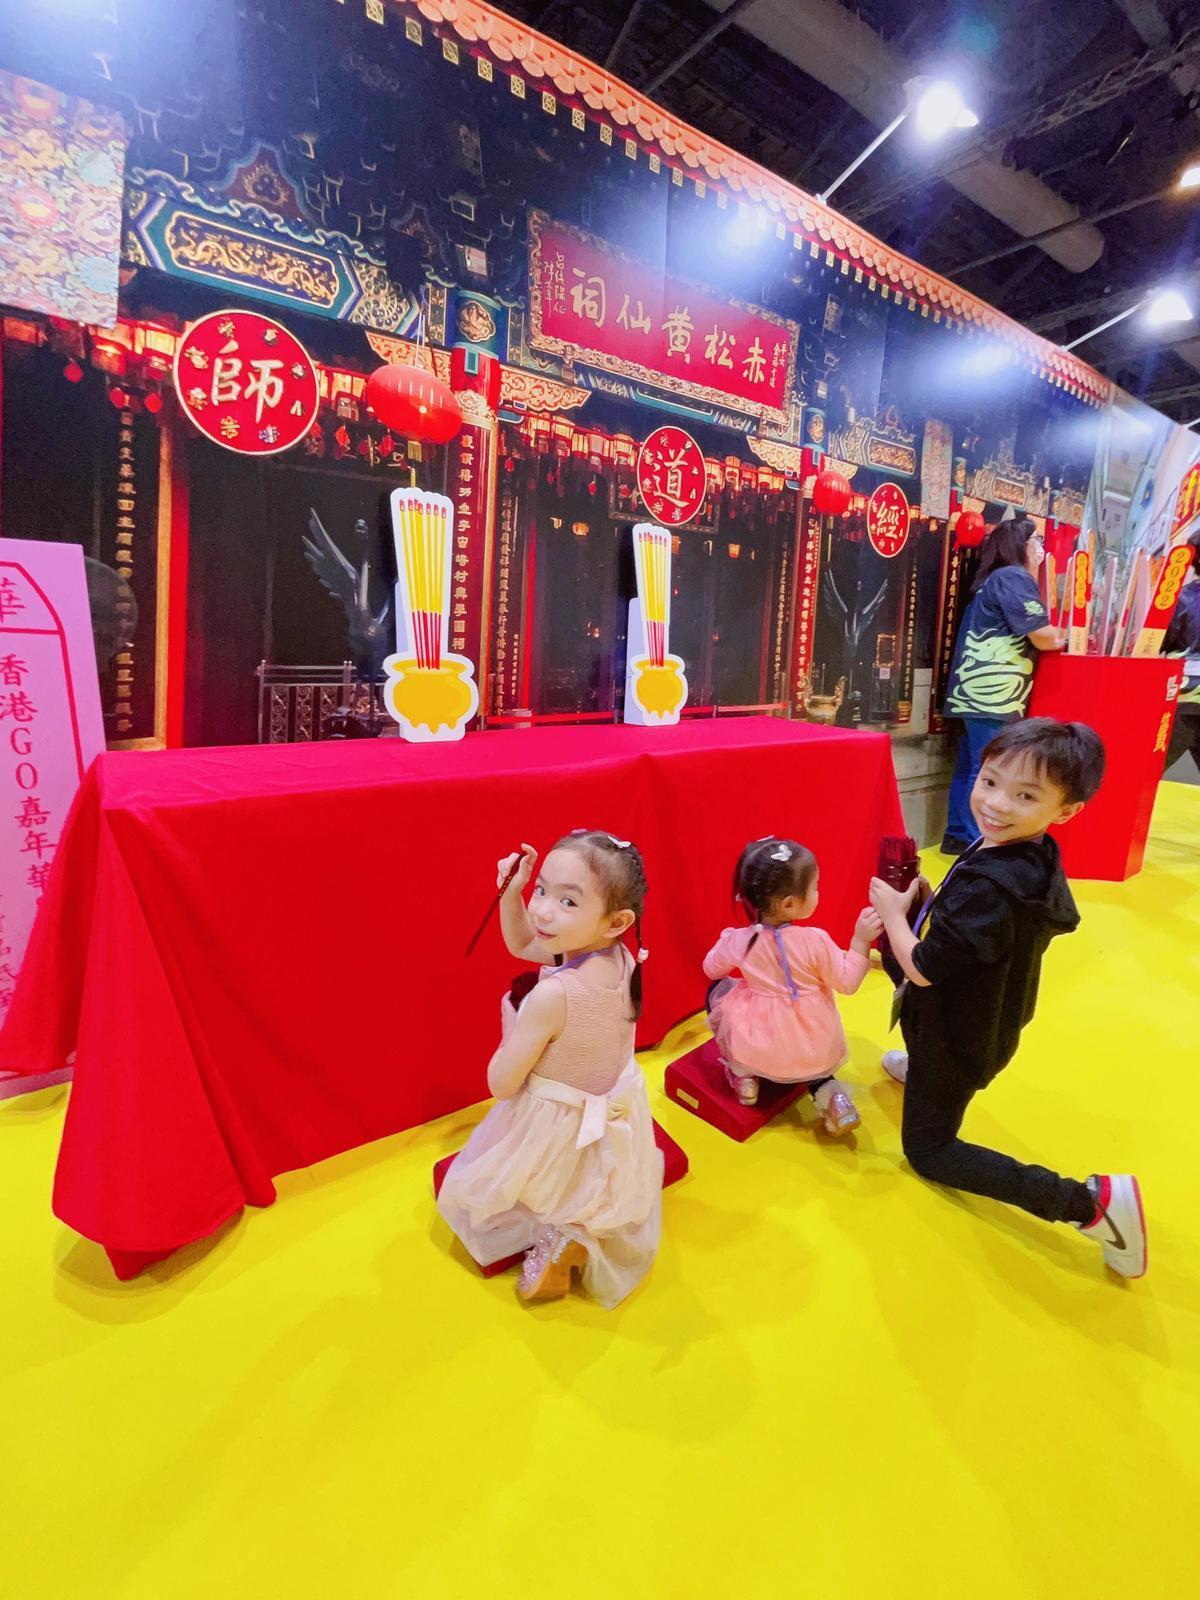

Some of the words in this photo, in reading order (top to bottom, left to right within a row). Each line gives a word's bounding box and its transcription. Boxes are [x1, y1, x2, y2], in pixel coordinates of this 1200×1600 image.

[211, 339, 285, 424] 師
[653, 448, 690, 508] 道
[876, 501, 899, 540] 經
[1158, 551, 1187, 608] 2022
[0, 653, 57, 902] 香港GO嘉年華
